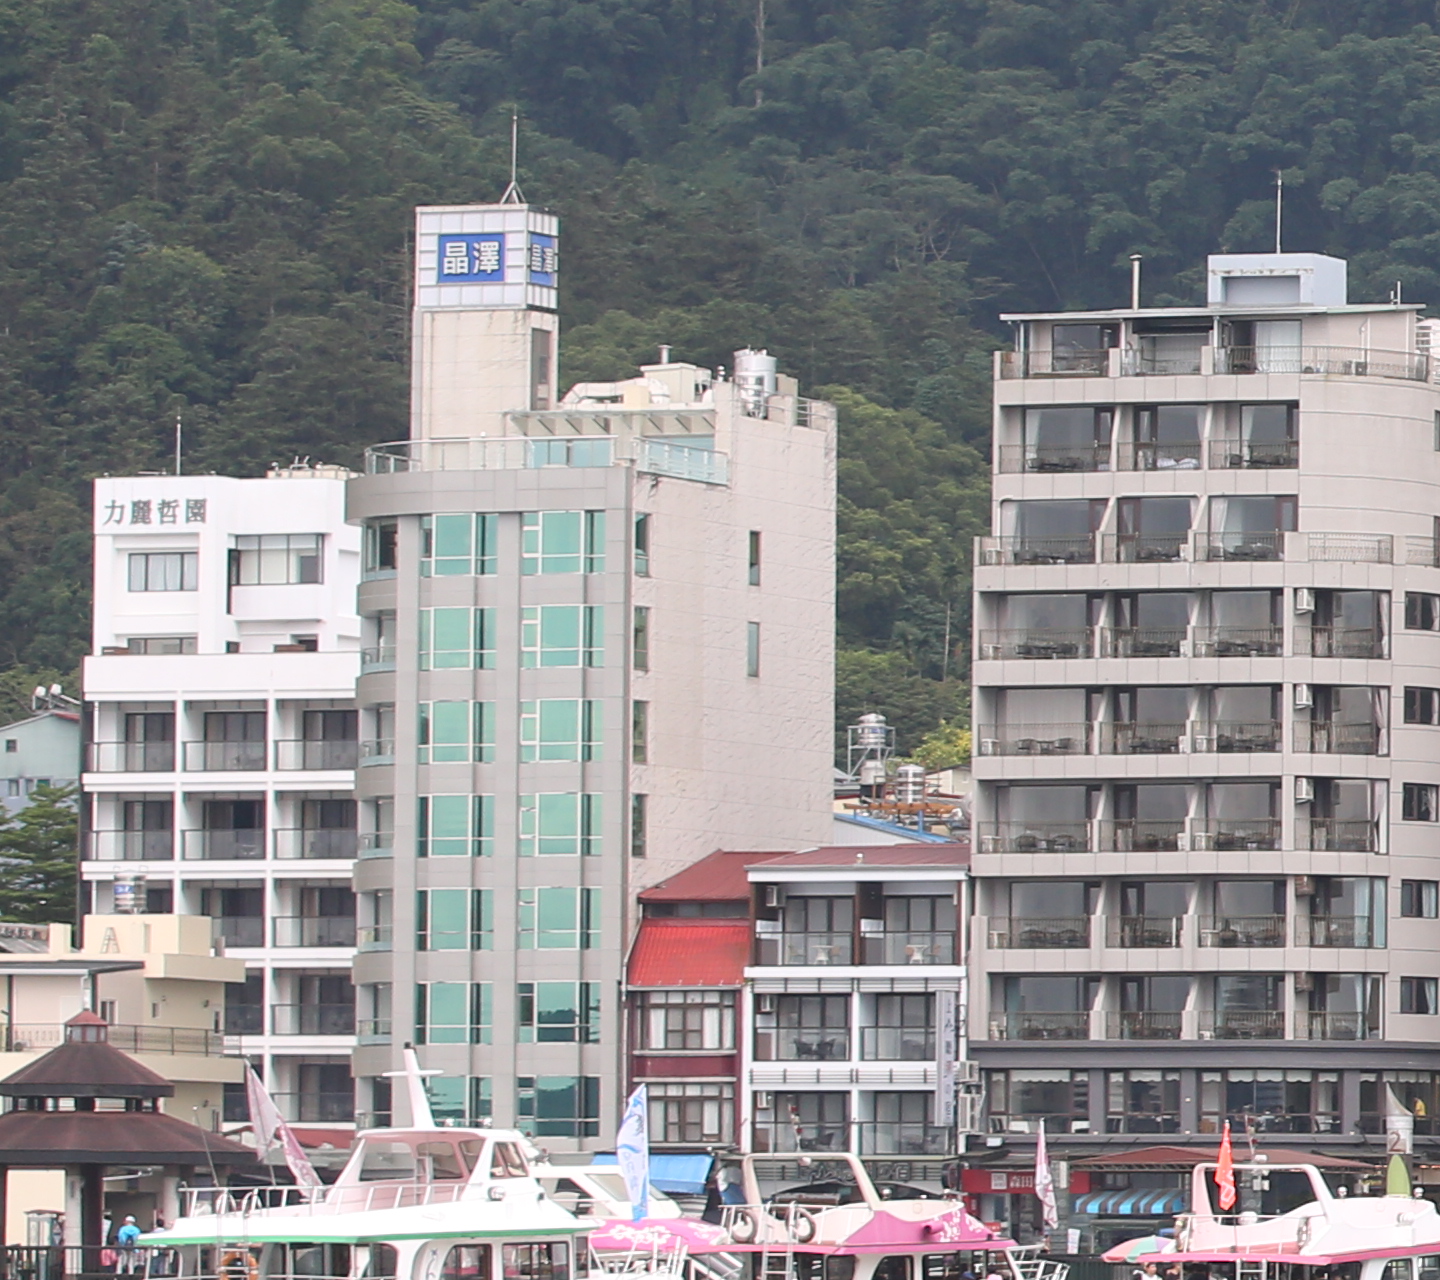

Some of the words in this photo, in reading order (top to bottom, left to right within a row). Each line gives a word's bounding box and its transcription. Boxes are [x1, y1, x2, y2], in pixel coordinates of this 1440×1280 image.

[443, 241, 500, 274] 晶澤
[102, 497, 208, 526] 力麗哲園
[1388, 1130, 1406, 1153] 2
